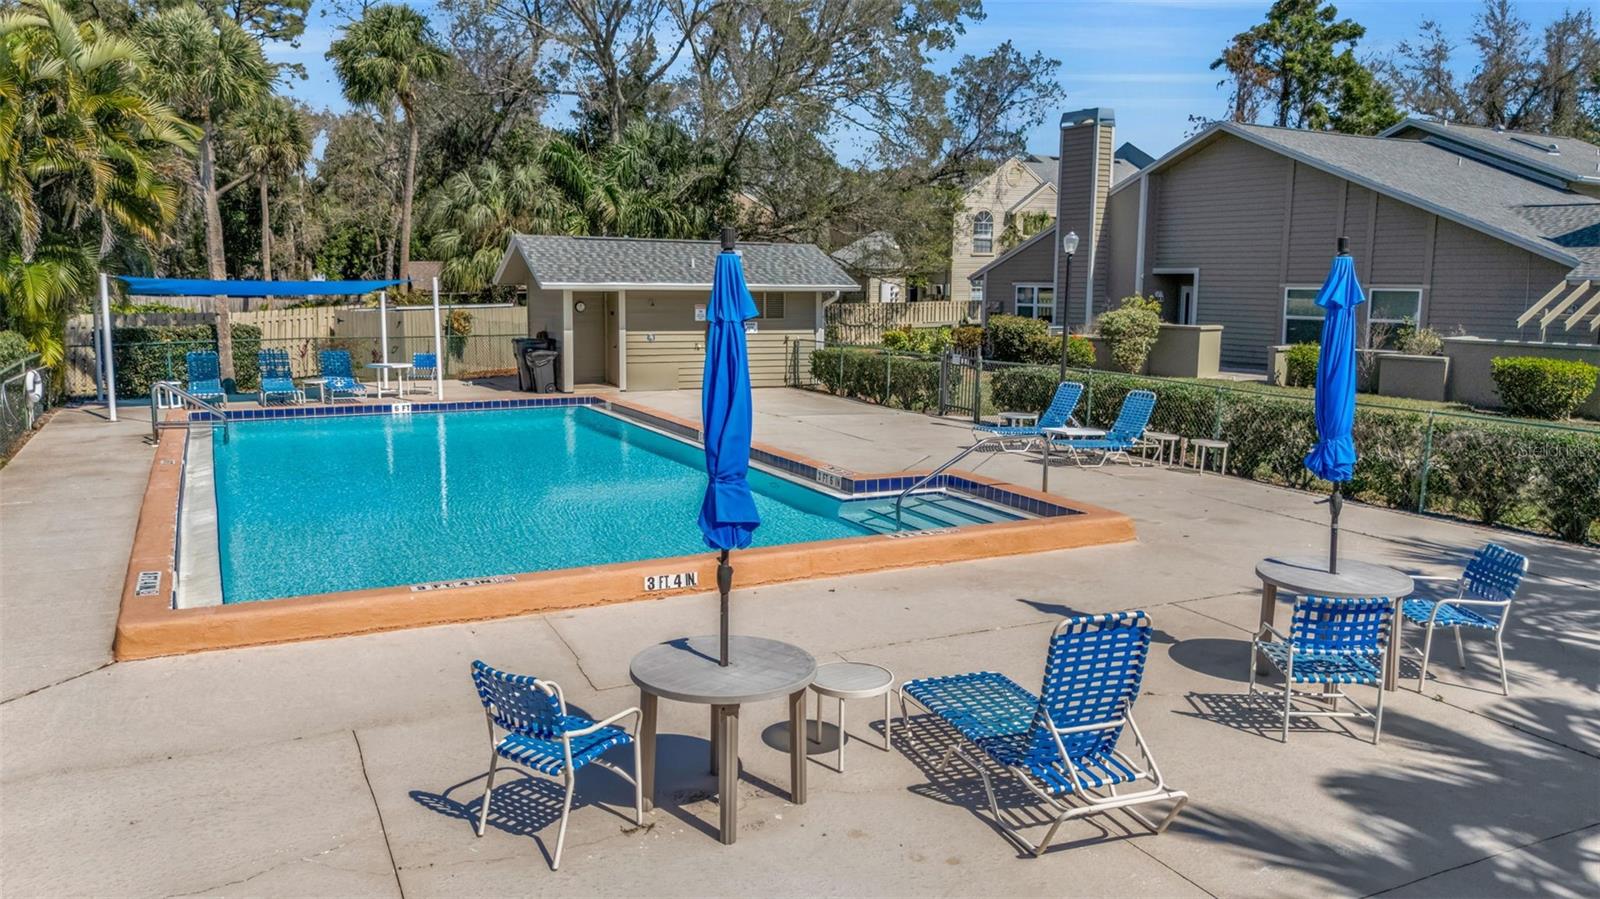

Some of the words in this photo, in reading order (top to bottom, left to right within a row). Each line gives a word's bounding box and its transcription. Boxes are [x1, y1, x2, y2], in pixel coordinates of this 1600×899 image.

[647, 576, 655, 590] 3
[659, 575, 671, 588] FT.
[674, 574, 682, 588] 4
[685, 572, 697, 586] IN.
